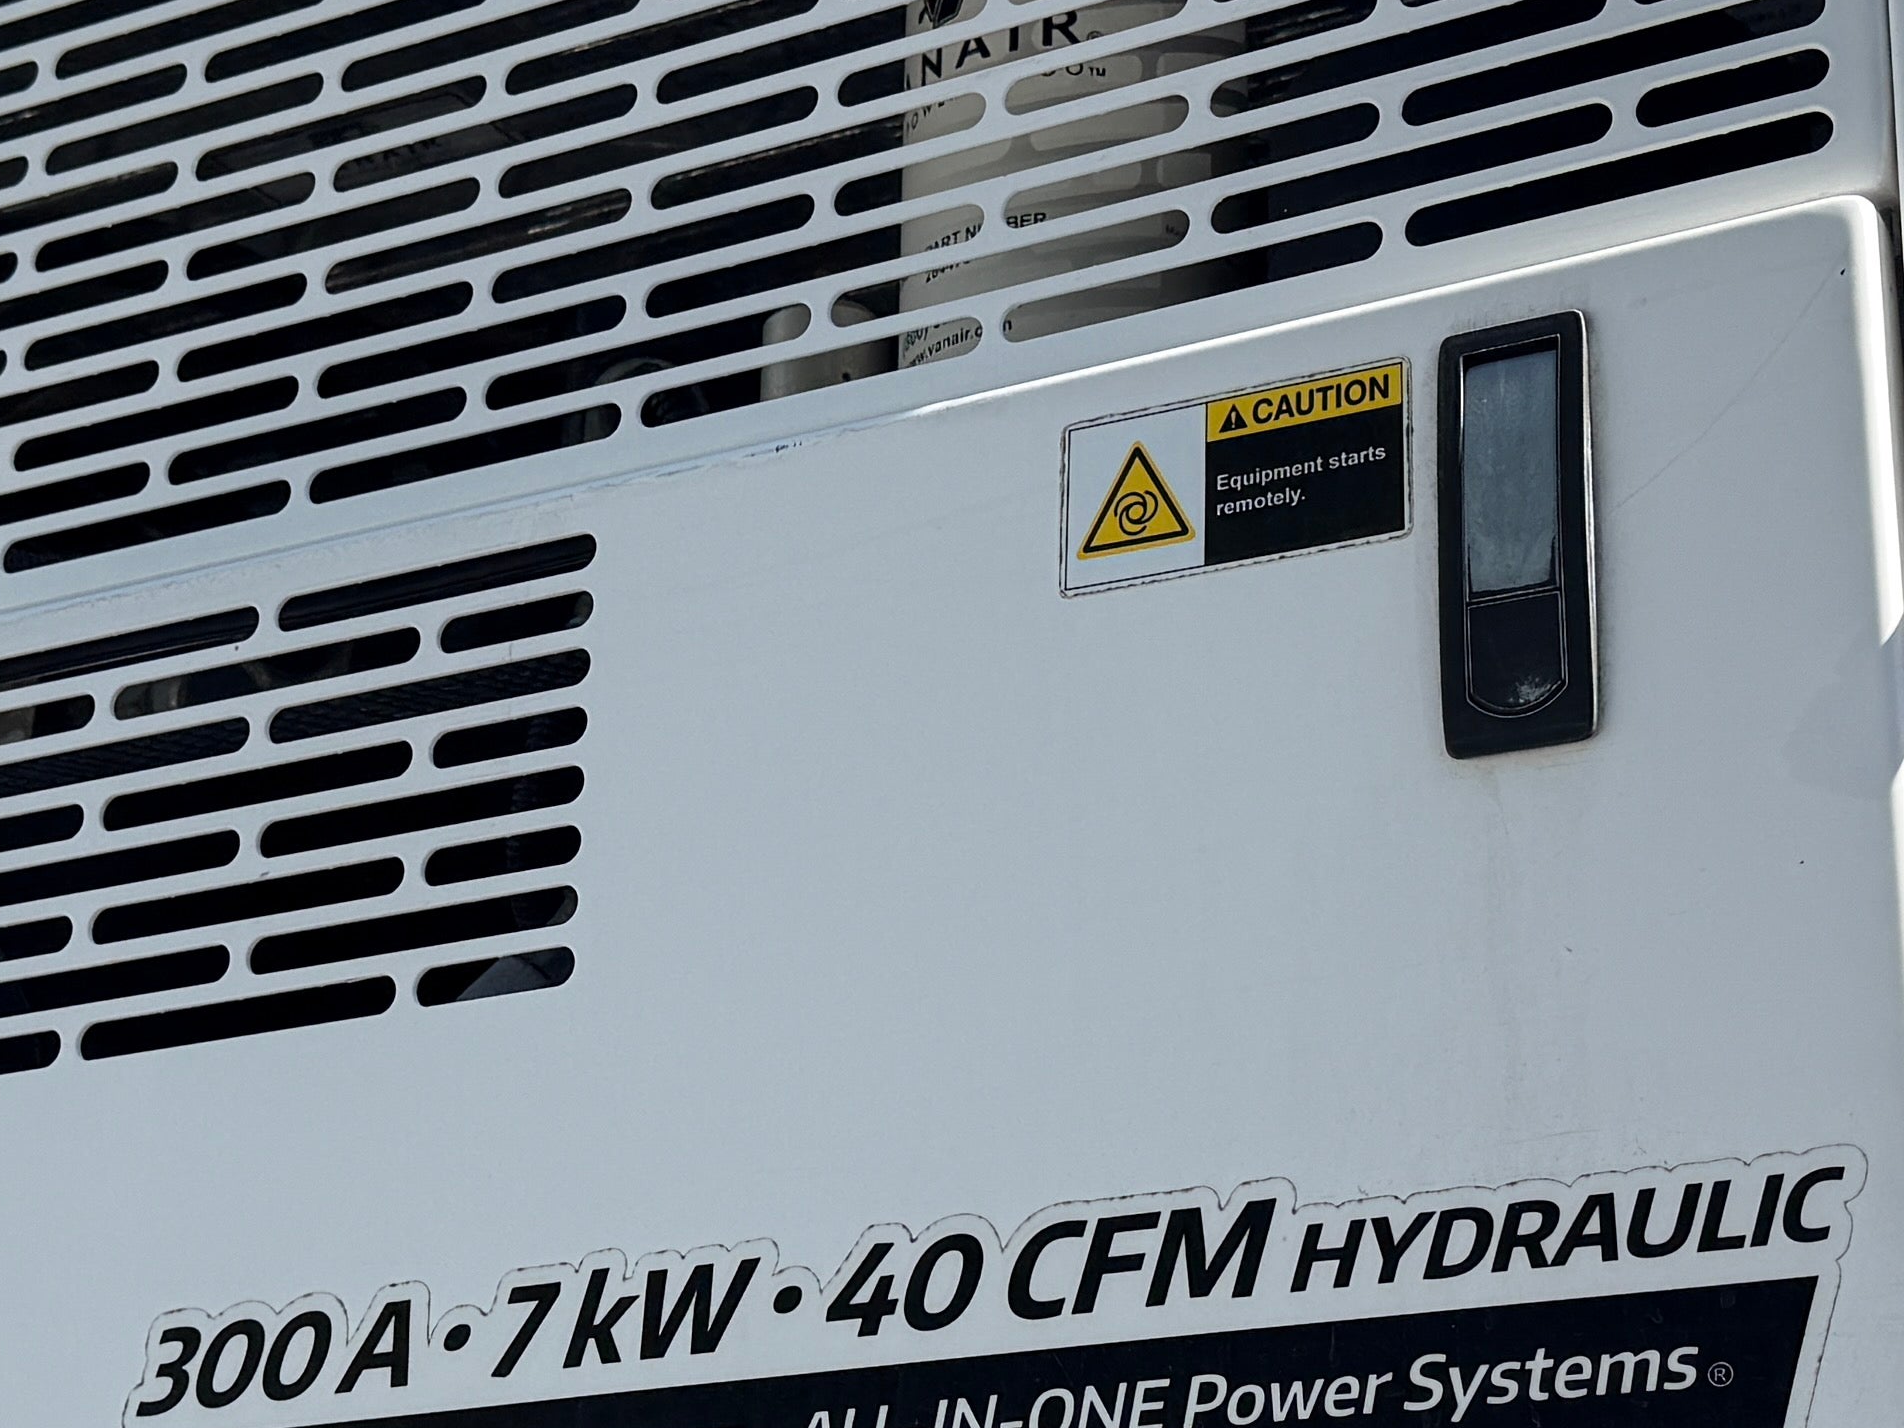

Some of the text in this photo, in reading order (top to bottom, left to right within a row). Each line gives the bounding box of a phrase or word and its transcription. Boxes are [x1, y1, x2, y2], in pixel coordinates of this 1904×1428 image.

[1252, 373, 1390, 424] CAUTION
[1216, 446, 1387, 492] Equipment starts
[1216, 487, 1307, 516] remotely.
[825, 1233, 985, 1338] 40
[1007, 1197, 1278, 1321] CFM
[1289, 1165, 1846, 1293] HYDRAULIC
